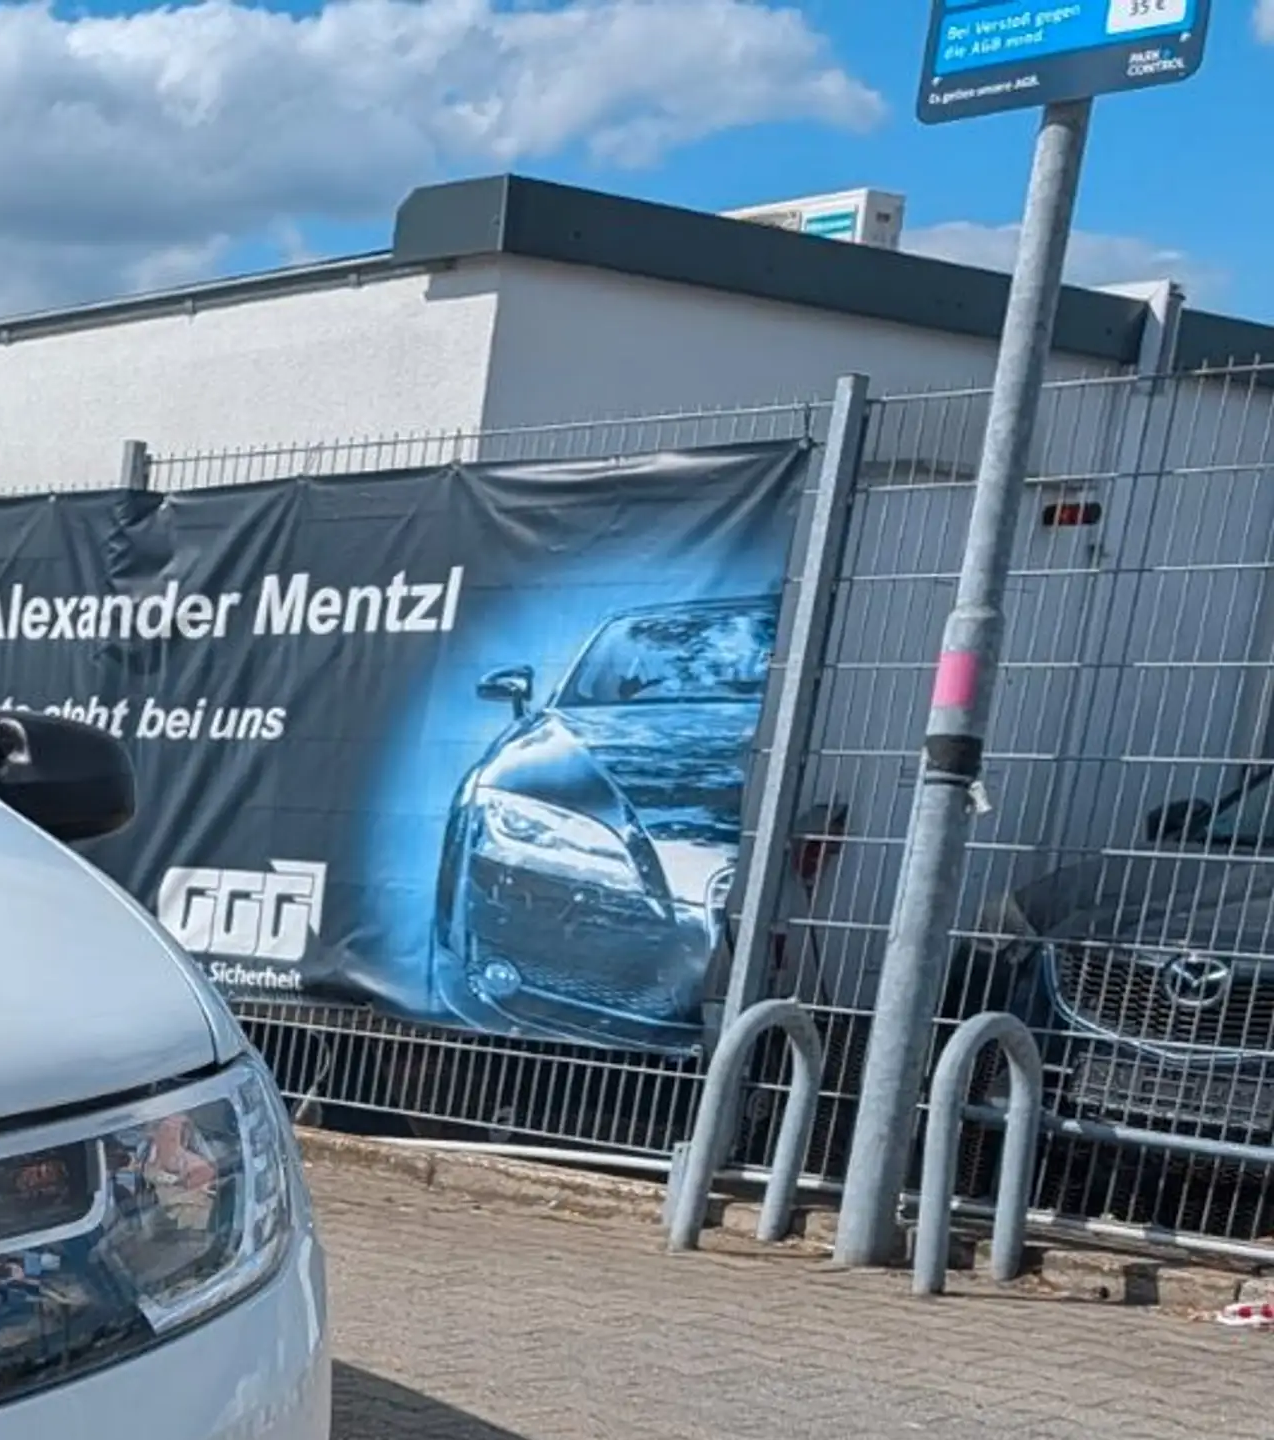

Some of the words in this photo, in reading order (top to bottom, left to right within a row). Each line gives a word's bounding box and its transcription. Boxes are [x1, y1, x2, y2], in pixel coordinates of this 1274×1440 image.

[253, 566, 465, 637] Mentzl
[137, 697, 208, 740] bei
[209, 705, 287, 740] uns
[209, 961, 304, 990] Sicherheit
